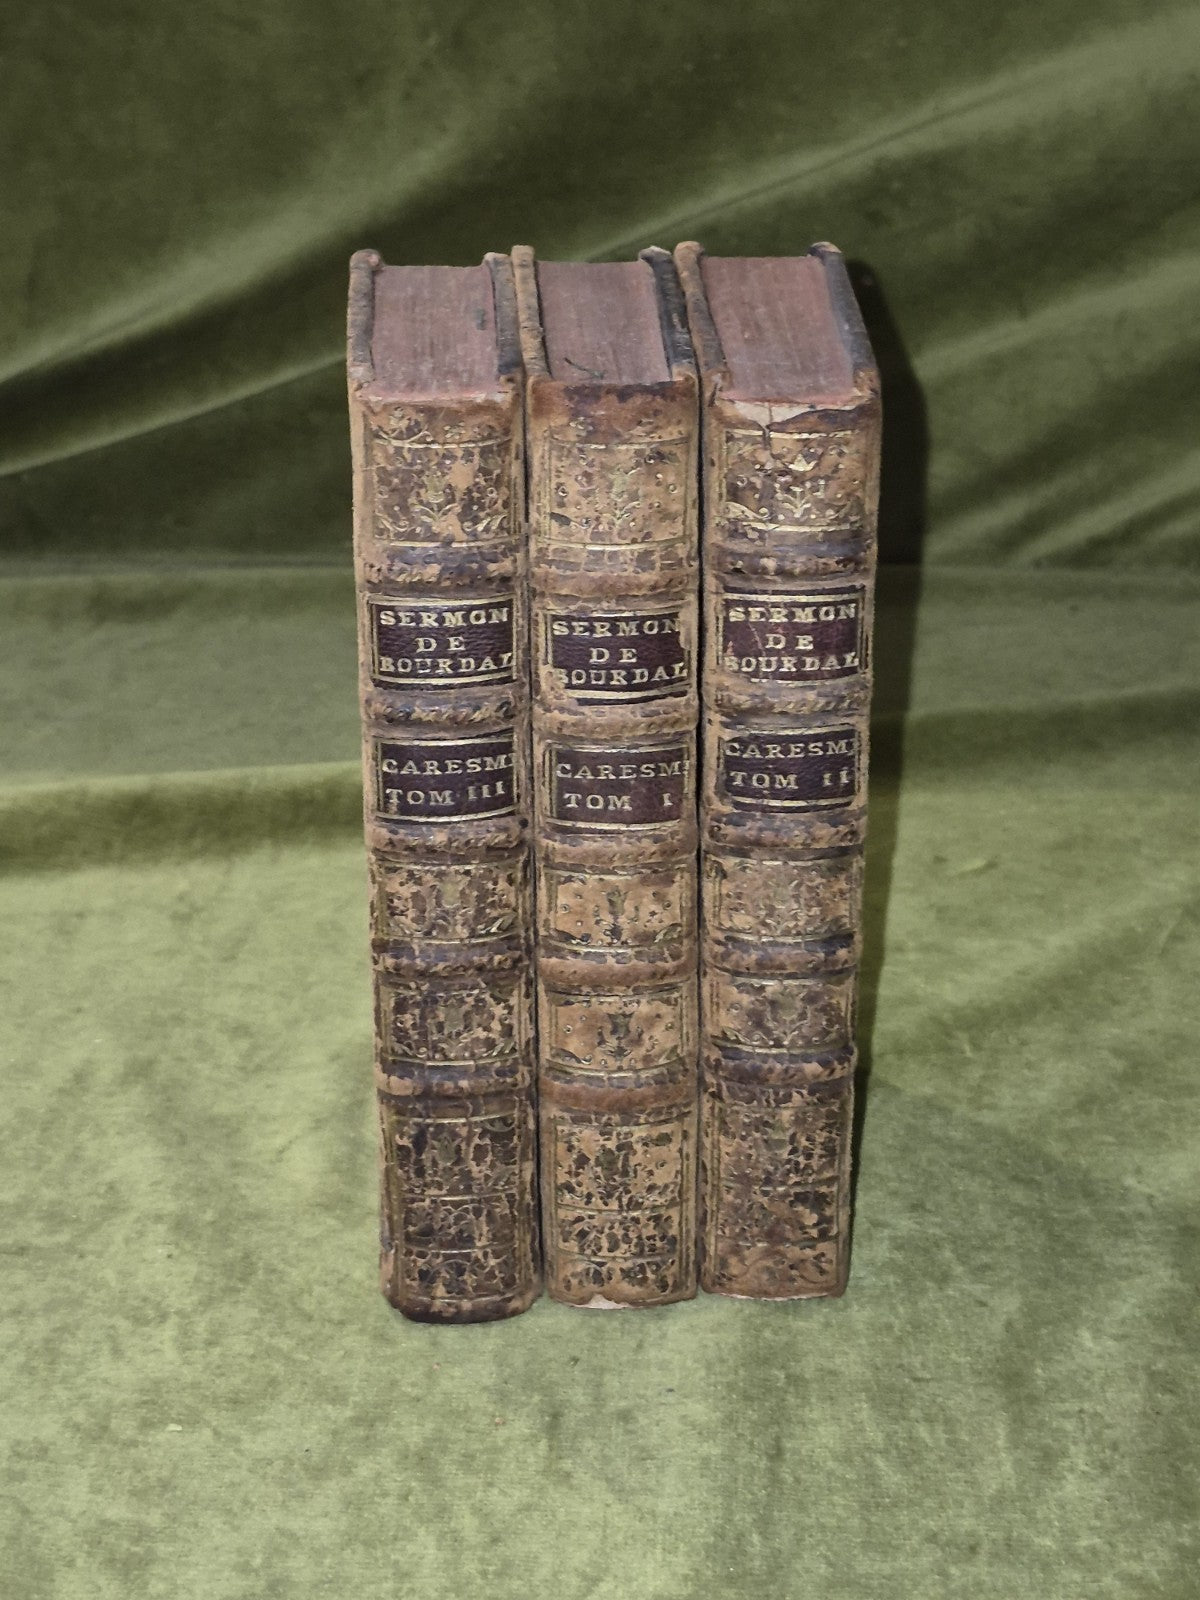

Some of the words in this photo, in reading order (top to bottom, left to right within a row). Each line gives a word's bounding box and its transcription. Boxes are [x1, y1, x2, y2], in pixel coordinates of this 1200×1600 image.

[380, 607, 509, 627] SERMON
[728, 603, 856, 623] SERMON
[552, 619, 681, 637] SERMON
[415, 636, 466, 653] DE
[765, 633, 815, 650] DE
[589, 647, 638, 663] DE
[730, 771, 799, 790] TOM
[822, 769, 850, 788] II
[385, 788, 455, 806] TOM
[468, 780, 506, 801] III
[563, 793, 633, 812] TOM
[662, 792, 674, 807] I
